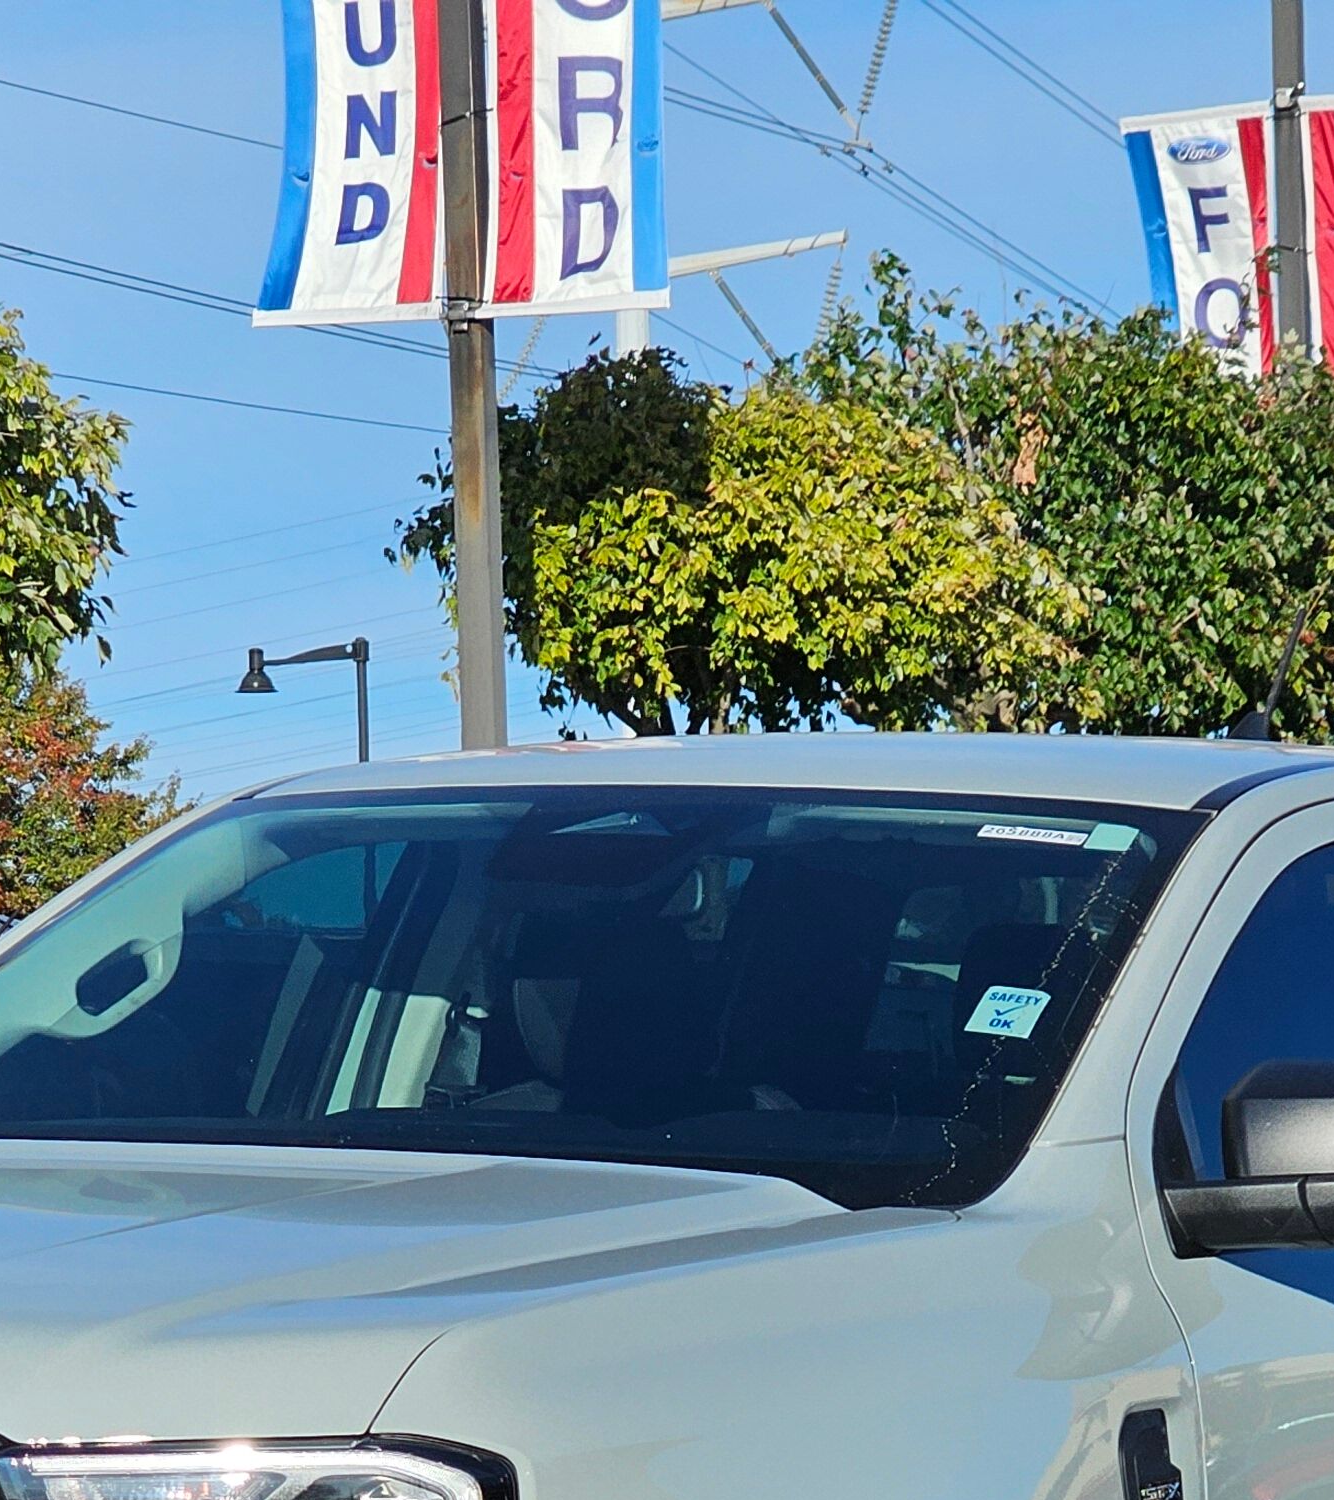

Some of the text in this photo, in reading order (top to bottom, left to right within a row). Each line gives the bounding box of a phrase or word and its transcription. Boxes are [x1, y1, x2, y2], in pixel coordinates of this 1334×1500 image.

[556, 0, 629, 281] RD
[988, 991, 1044, 1006] SAFETY
[988, 1017, 1015, 1030] OK
